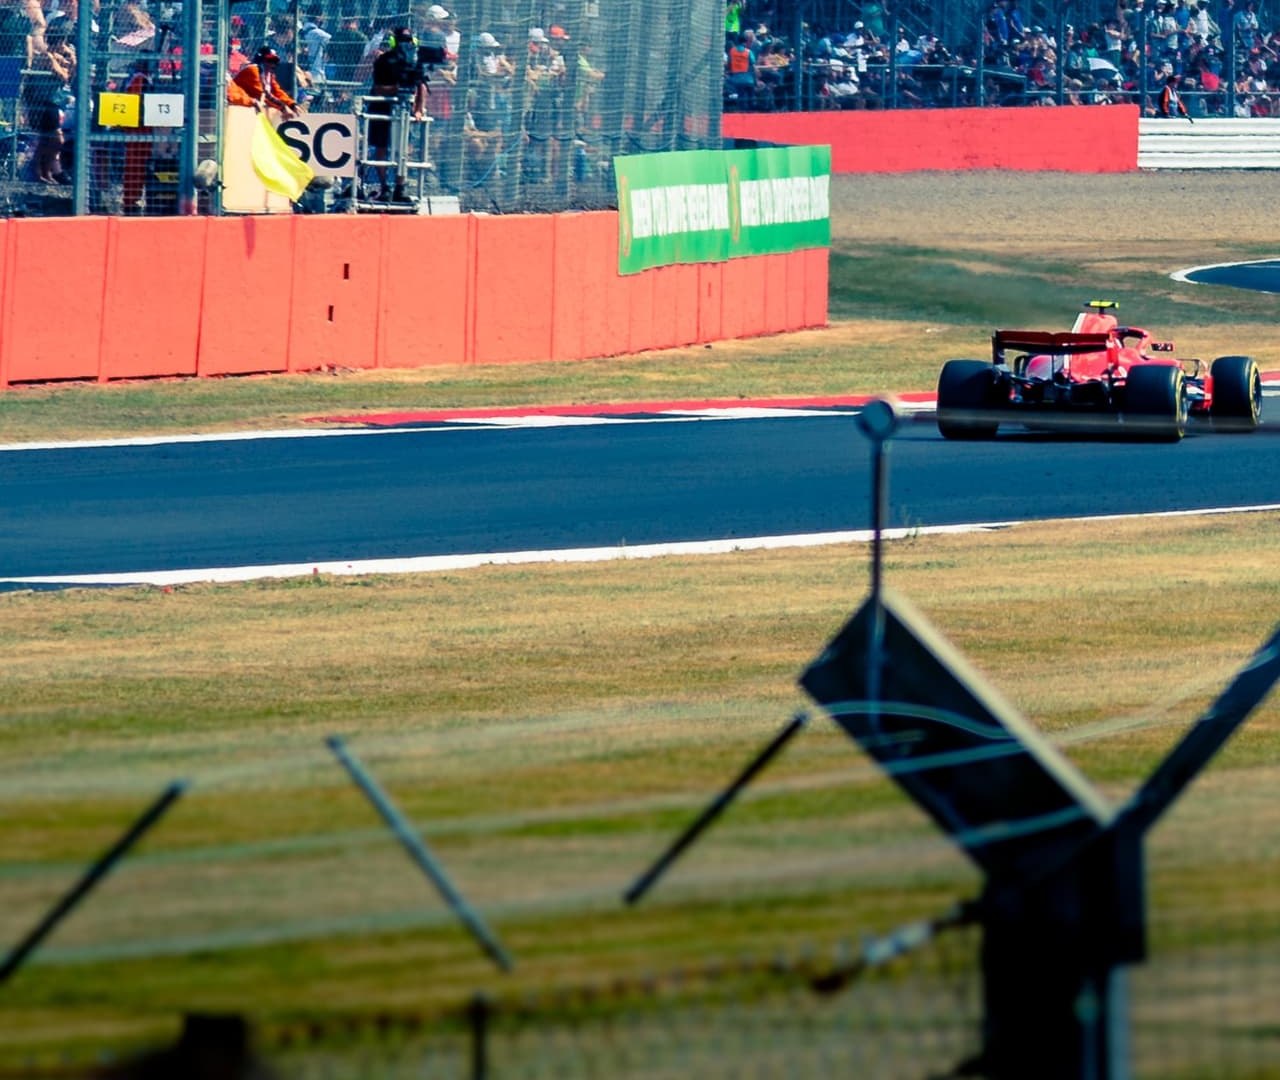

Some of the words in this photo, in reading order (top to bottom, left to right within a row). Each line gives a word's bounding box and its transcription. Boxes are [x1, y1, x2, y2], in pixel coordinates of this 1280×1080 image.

[113, 103, 127, 114] F2
[158, 103, 171, 114] T3
[276, 121, 352, 169] SC
